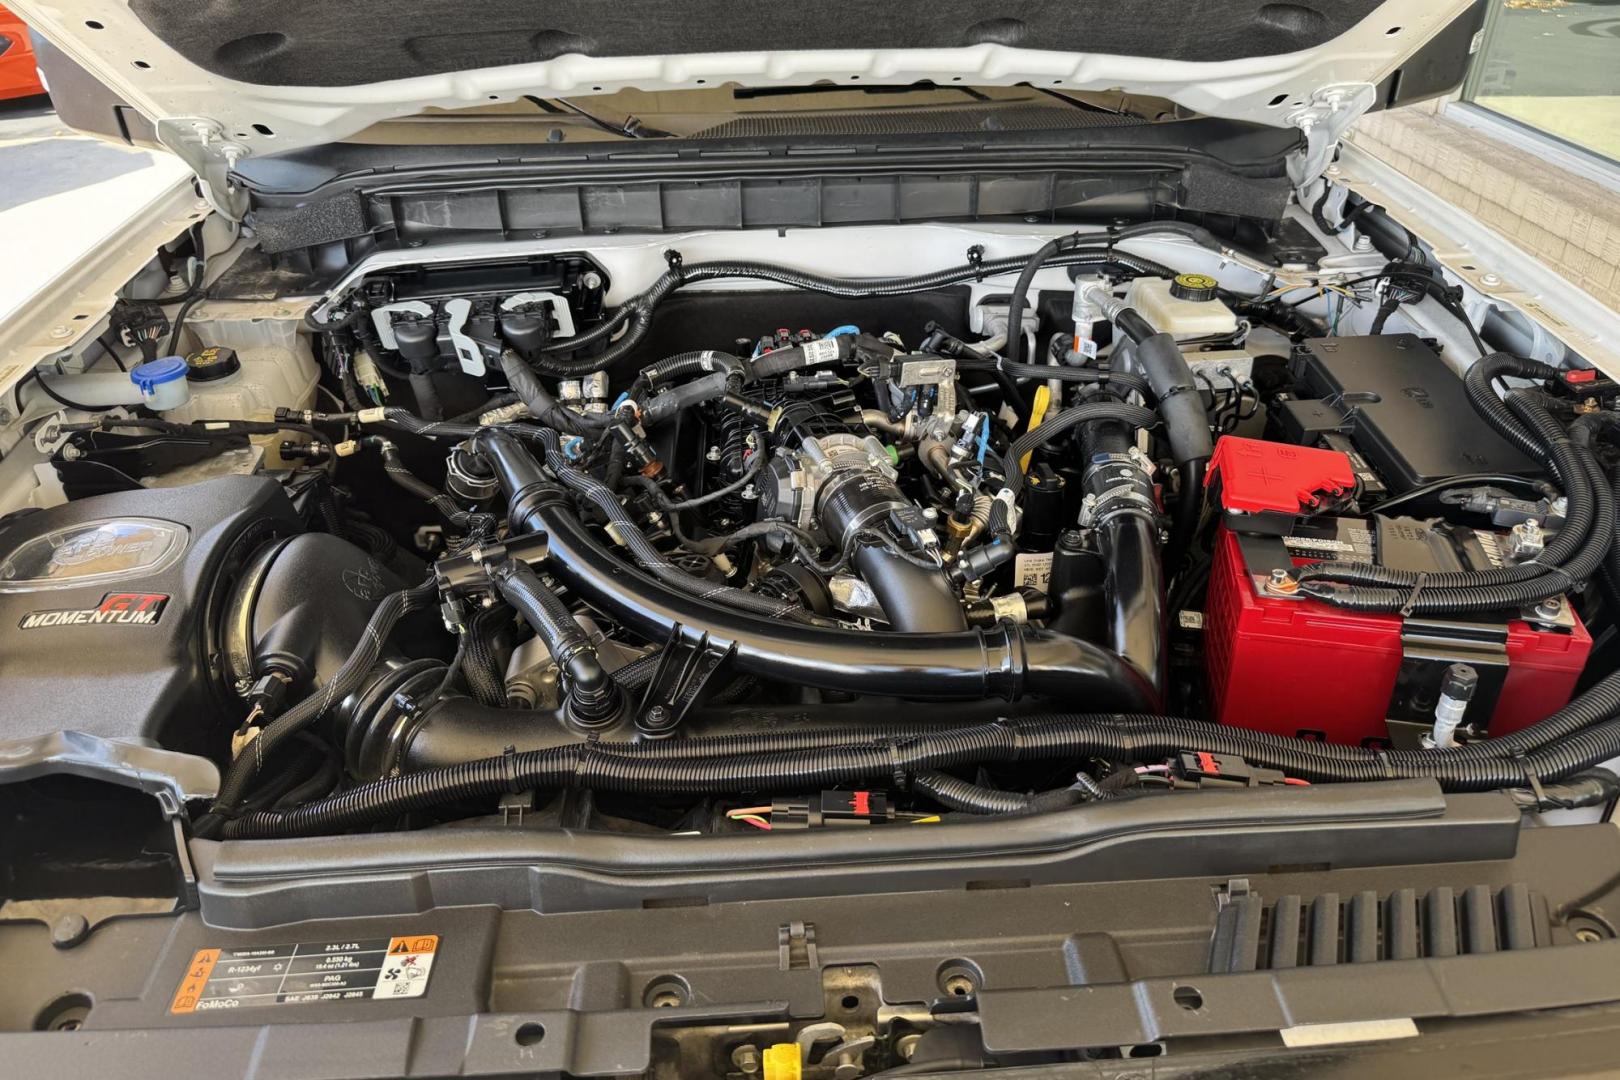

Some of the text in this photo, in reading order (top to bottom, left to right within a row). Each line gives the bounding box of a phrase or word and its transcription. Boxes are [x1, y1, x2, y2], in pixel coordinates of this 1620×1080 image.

[101, 593, 169, 612] GT
[227, 964, 262, 974] R-1234yf
[323, 974, 341, 982] PAG
[196, 999, 239, 1011] FoMoCo
